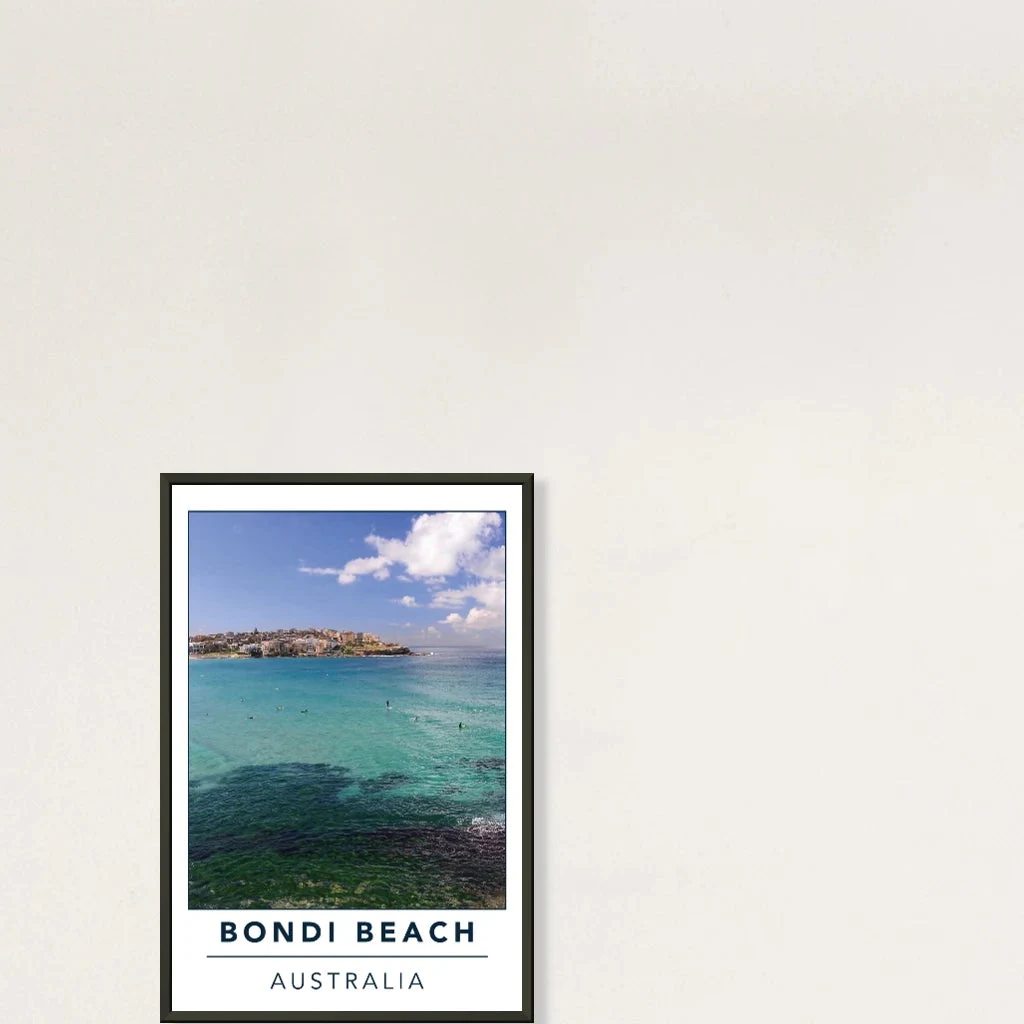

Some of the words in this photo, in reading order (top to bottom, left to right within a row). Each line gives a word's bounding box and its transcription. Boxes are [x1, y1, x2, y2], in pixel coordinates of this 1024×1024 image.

[220, 920, 335, 944] BONDI
[356, 920, 474, 944] BEACH
[270, 971, 424, 991] AUSTRALIA
